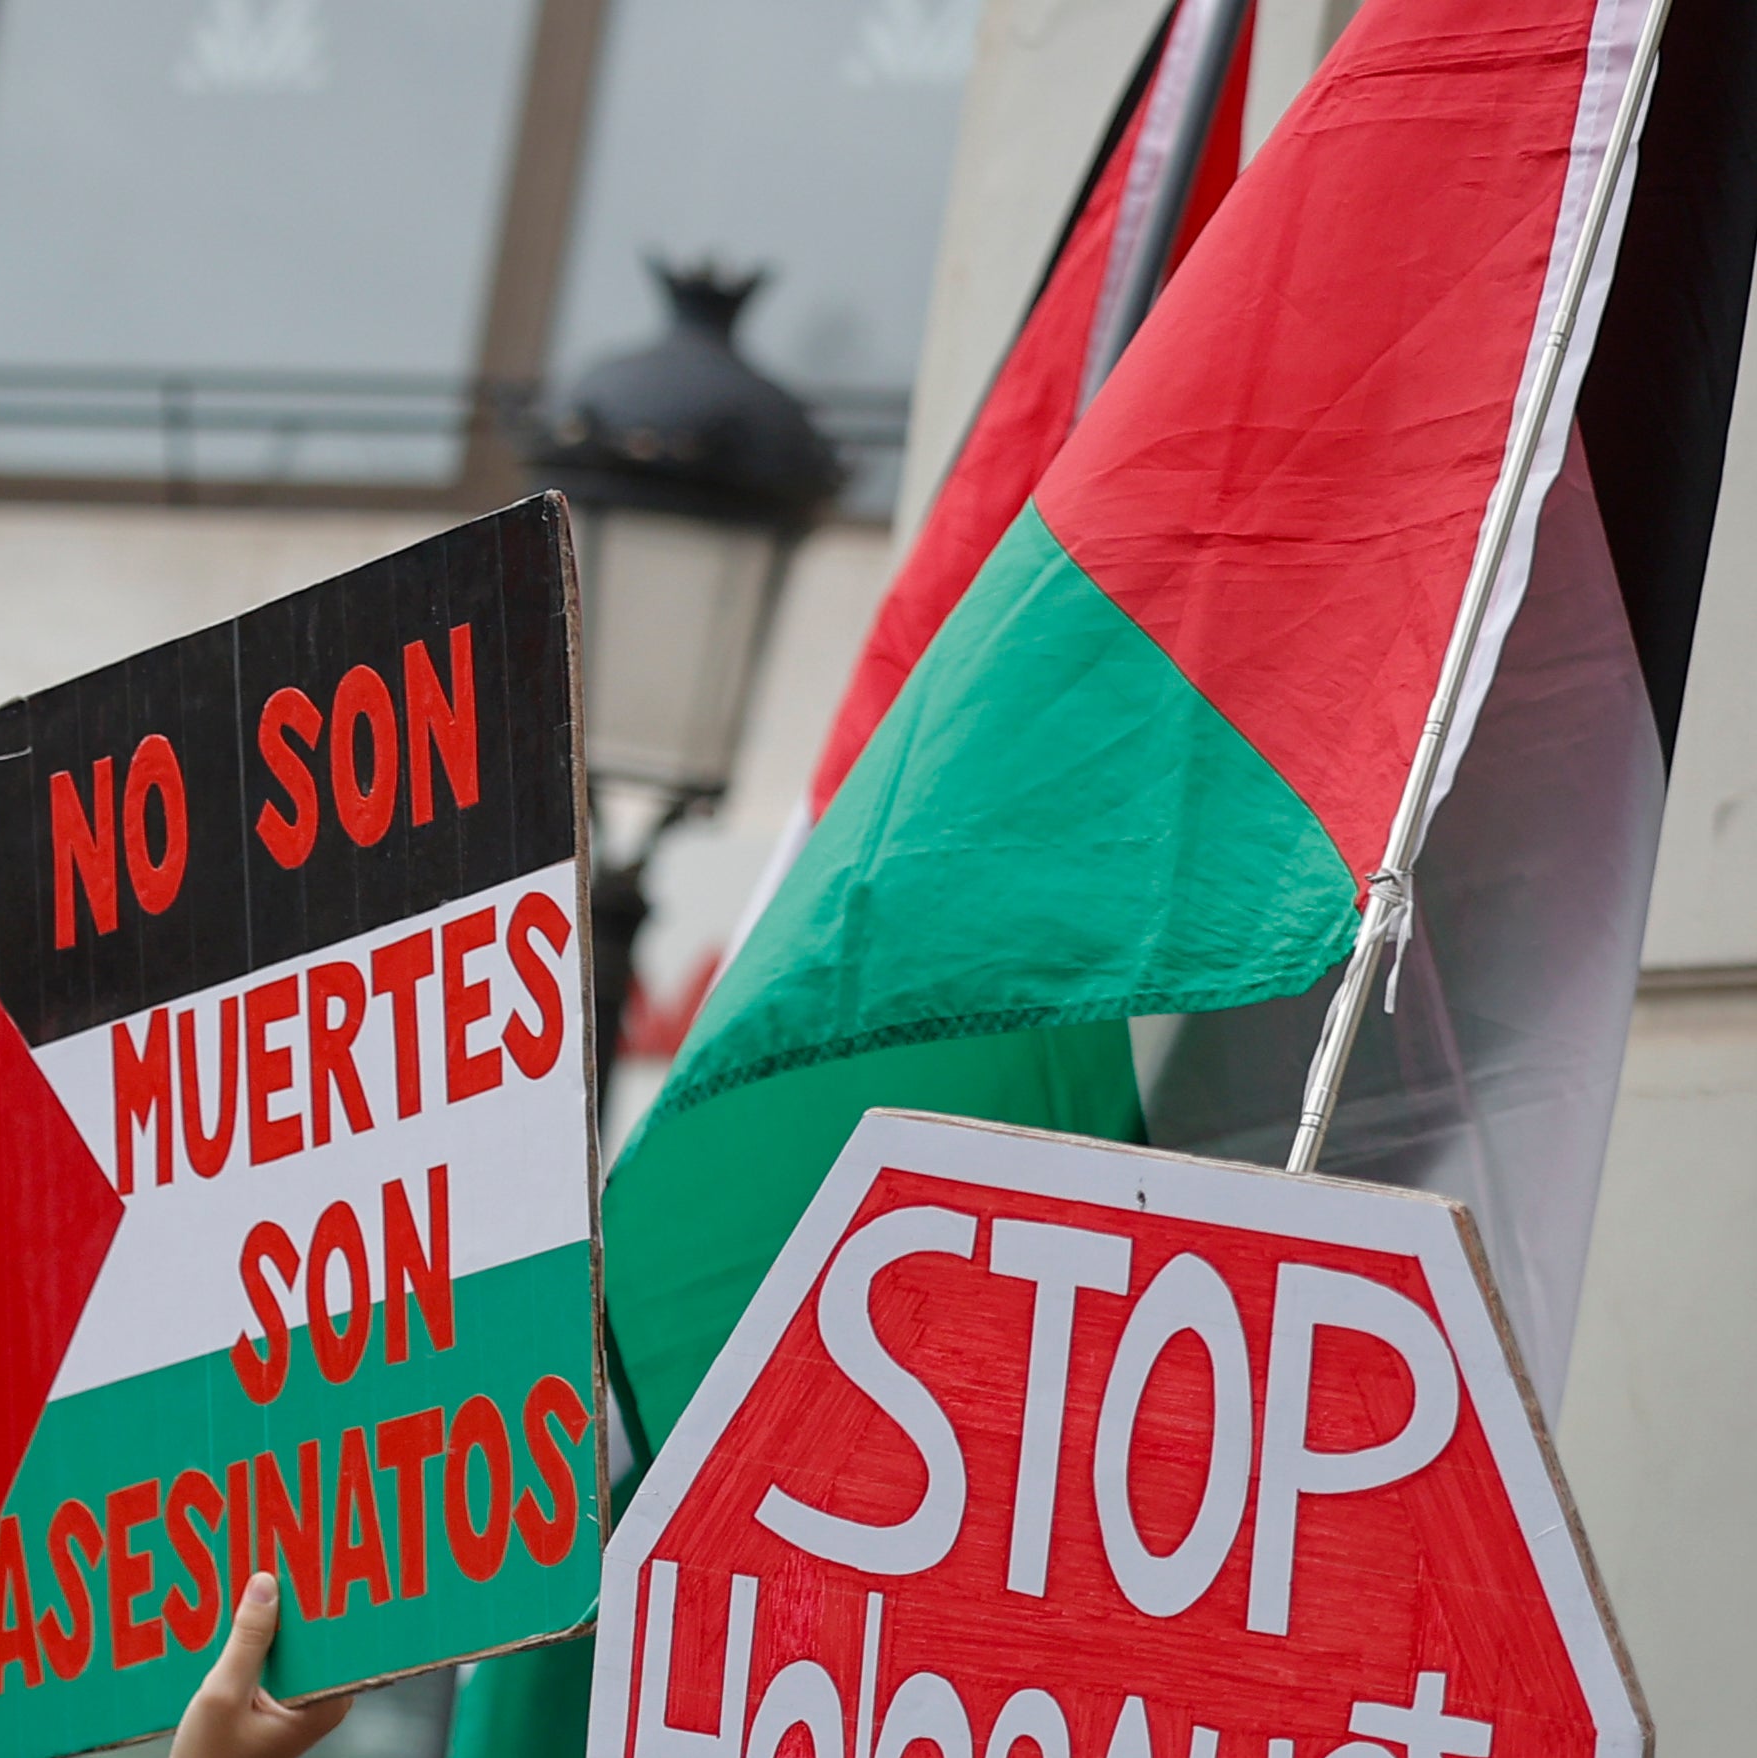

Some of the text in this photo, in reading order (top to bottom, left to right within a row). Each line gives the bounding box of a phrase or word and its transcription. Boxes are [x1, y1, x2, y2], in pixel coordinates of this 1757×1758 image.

[49, 622, 480, 951] NO SON
[112, 891, 572, 1195] MUERTES
[230, 1165, 456, 1406] SON
[755, 1205, 1460, 1637] STOP
